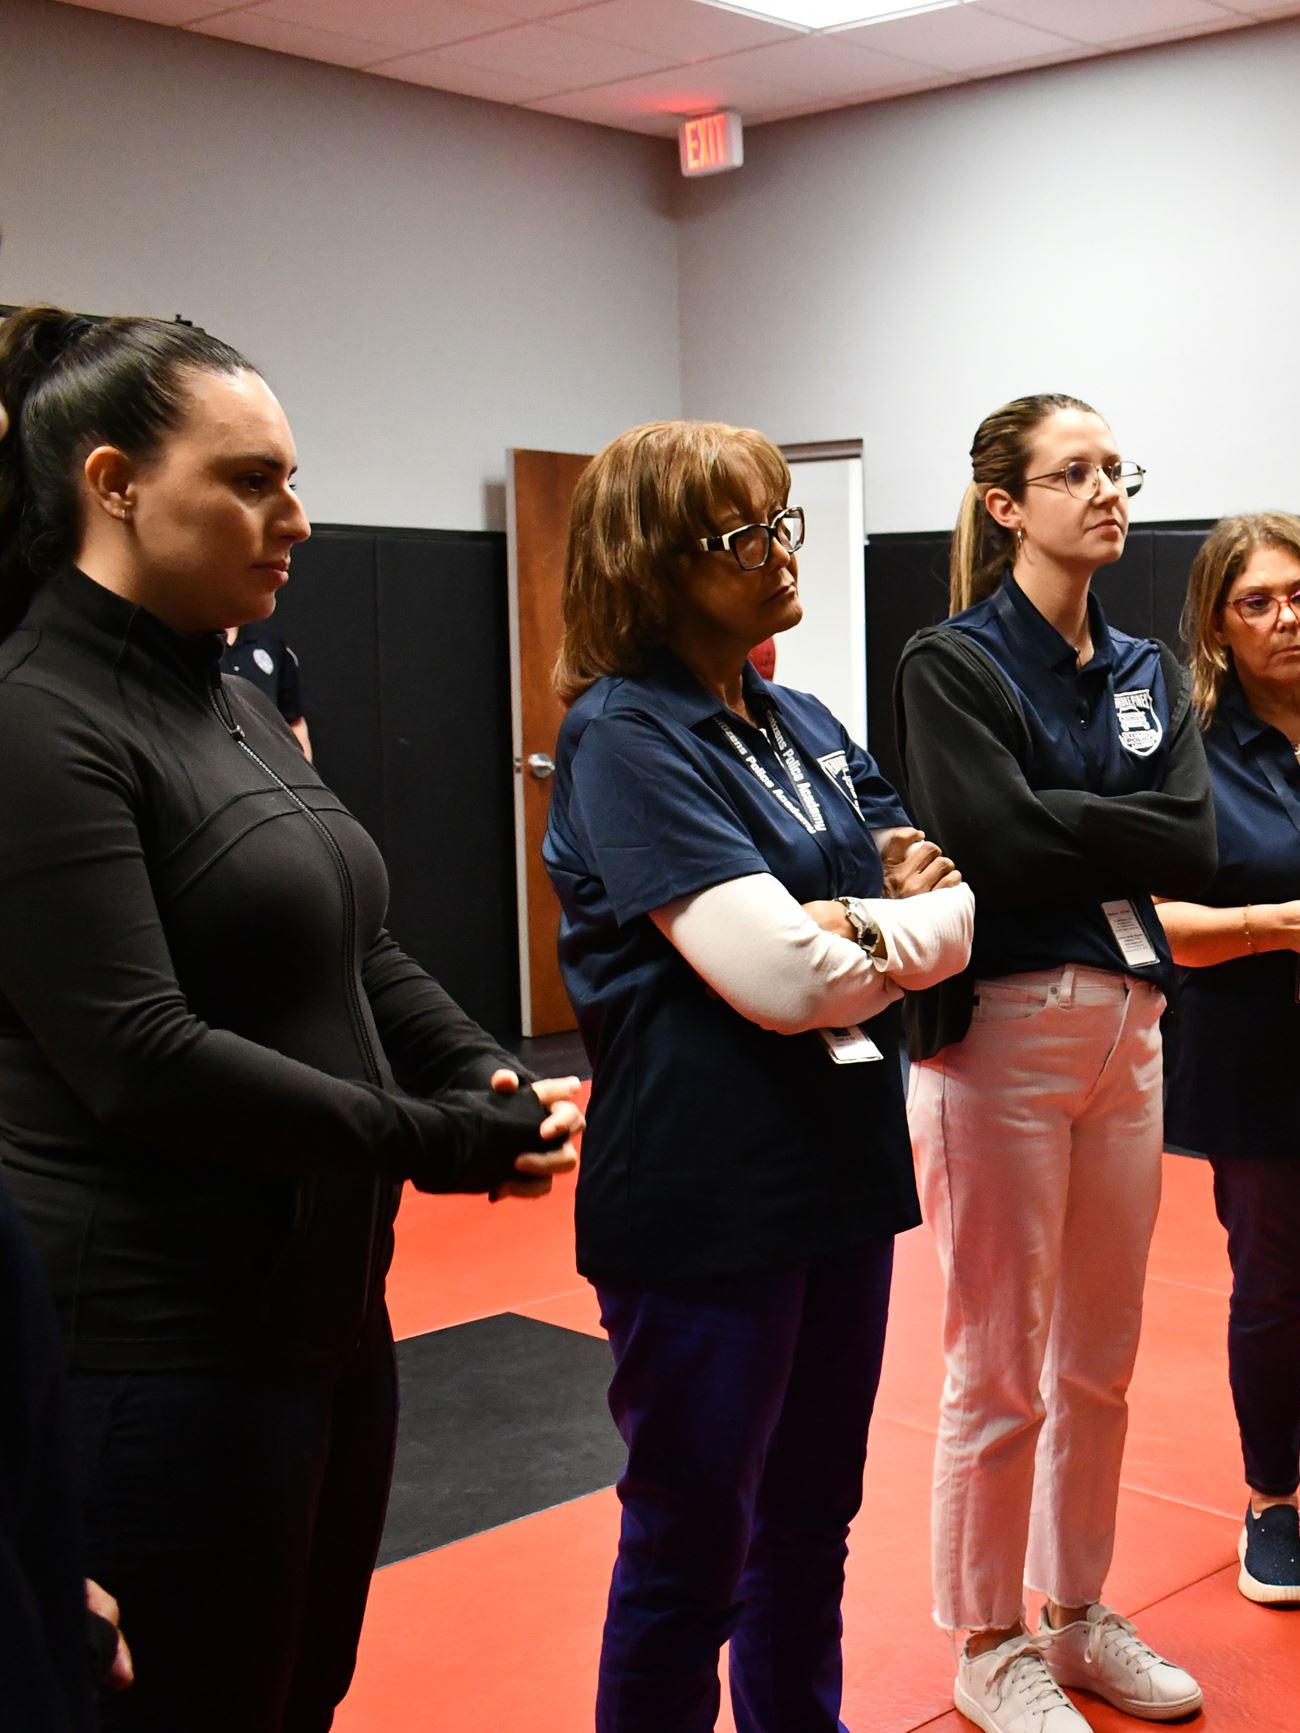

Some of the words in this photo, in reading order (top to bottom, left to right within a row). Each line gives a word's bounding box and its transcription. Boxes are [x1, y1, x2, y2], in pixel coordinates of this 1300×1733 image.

[685, 114, 726, 170] EXIT
[745, 755, 775, 788] Police
[772, 789, 817, 834] Academy
[782, 748, 804, 782] Police
[797, 782, 827, 831] Academy
